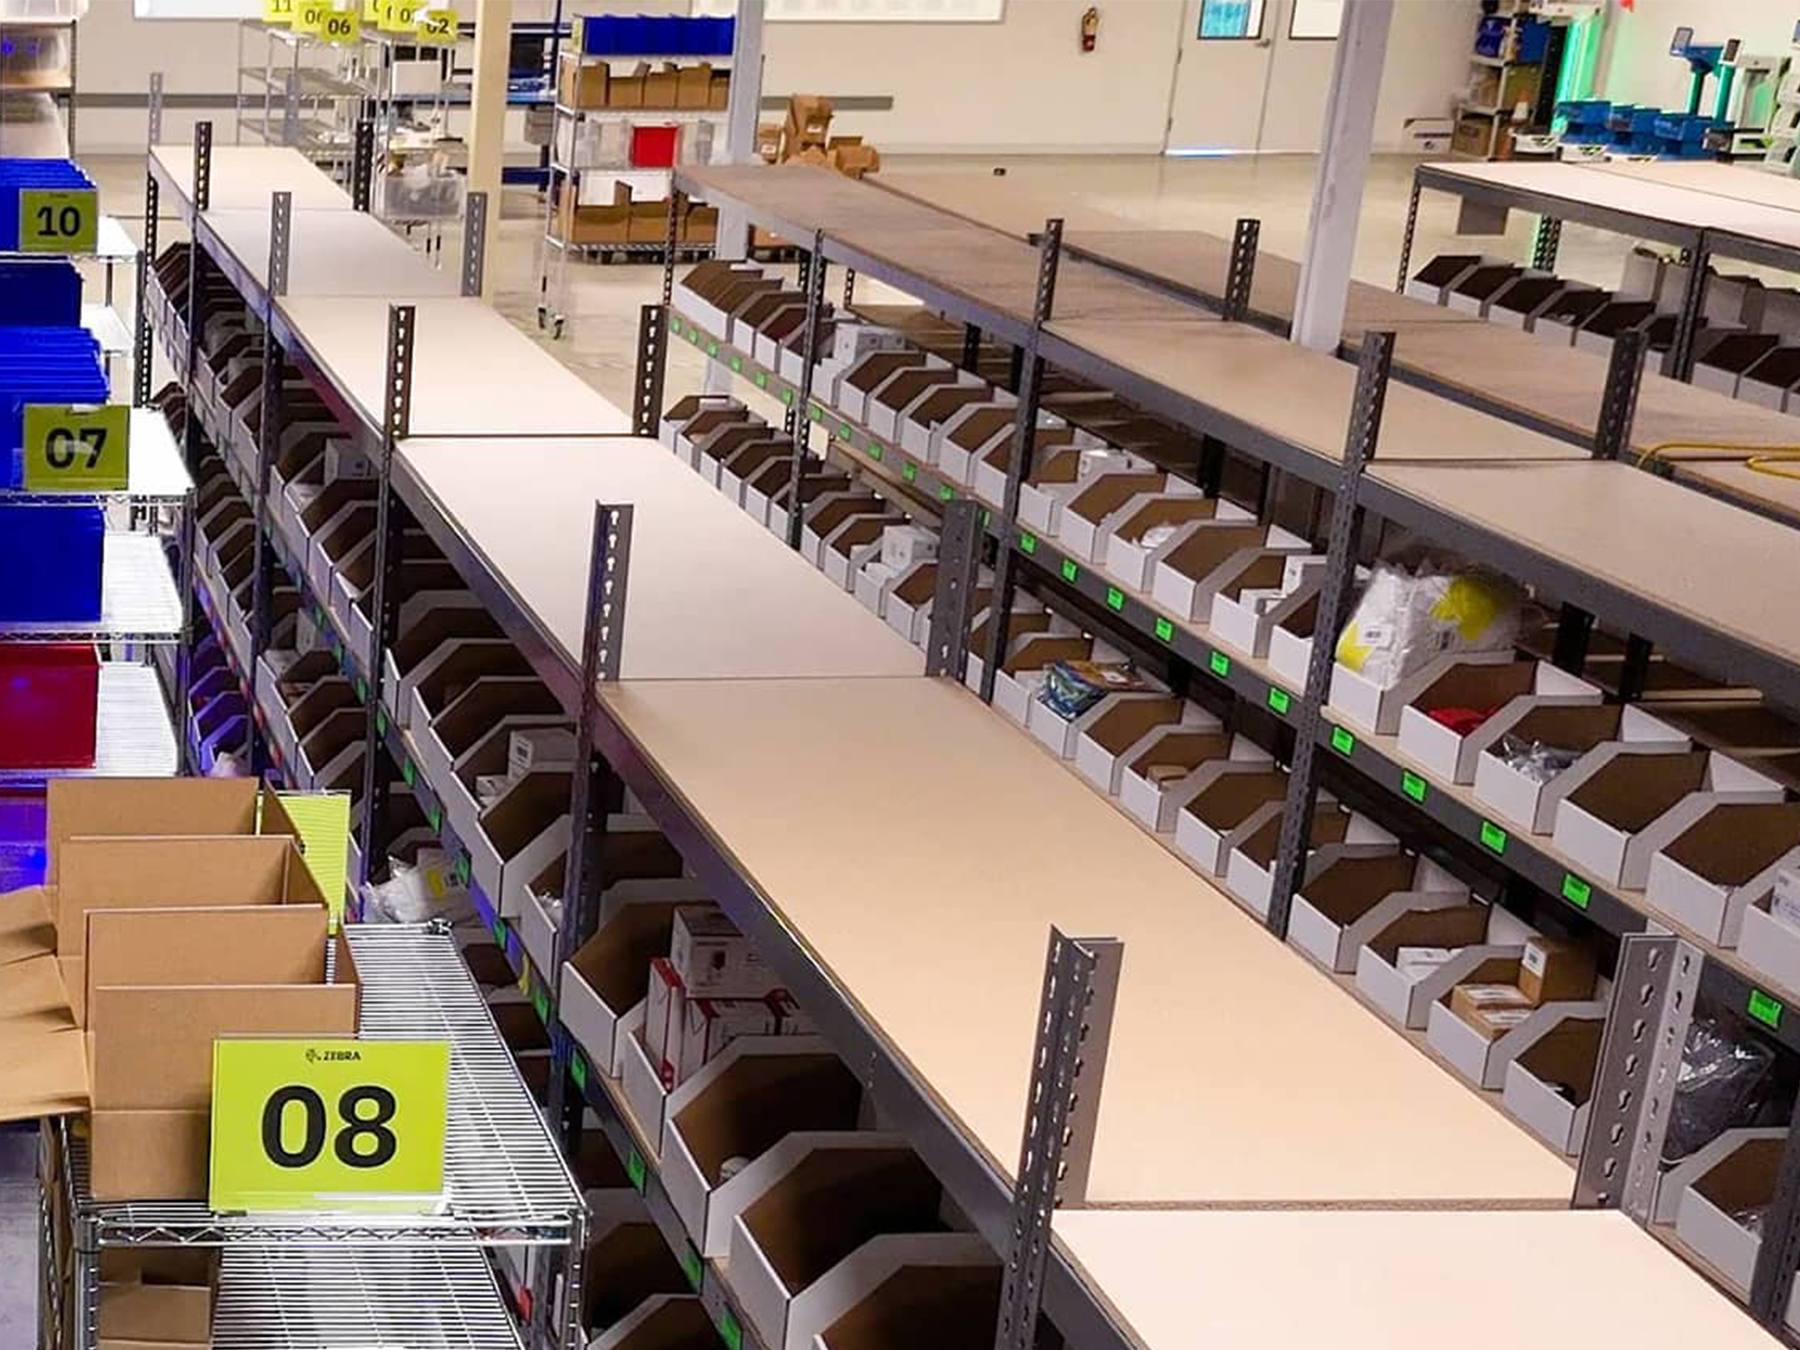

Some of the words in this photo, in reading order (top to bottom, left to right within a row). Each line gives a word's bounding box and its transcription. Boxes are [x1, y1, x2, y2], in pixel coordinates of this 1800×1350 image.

[327, 18, 351, 35] 06
[37, 205, 80, 237] 10
[45, 428, 108, 469] 07
[323, 1050, 361, 1060] ZEBRA
[261, 1085, 397, 1168] 08
